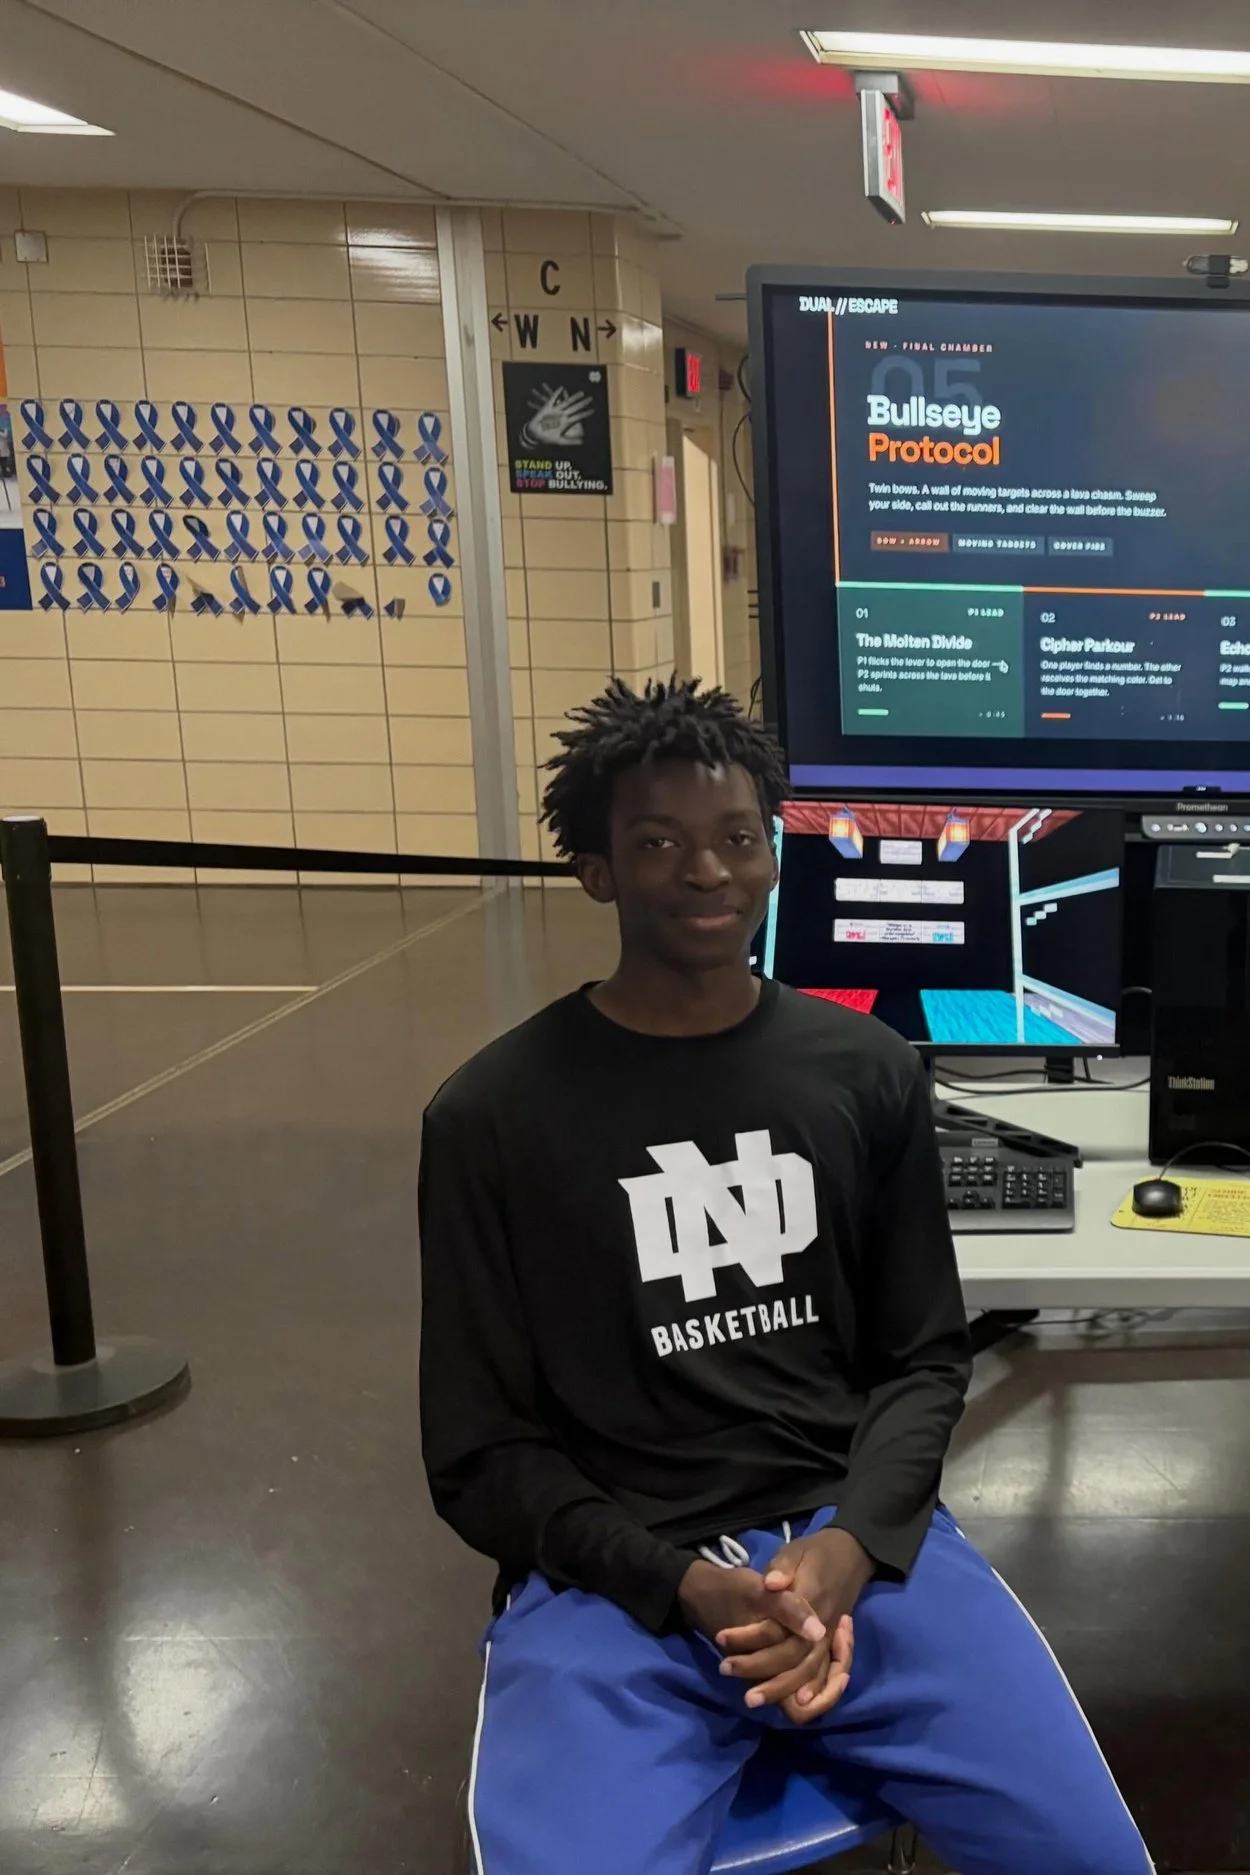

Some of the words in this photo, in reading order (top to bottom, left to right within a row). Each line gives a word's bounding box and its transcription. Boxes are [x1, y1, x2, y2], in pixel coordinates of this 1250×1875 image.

[540, 260, 561, 296] C
[514, 314, 539, 349] W
[570, 317, 592, 352] N
[865, 341, 888, 350] NEW
[903, 342, 935, 351] FINAL
[940, 343, 993, 352] CHAMBER
[867, 394, 1001, 436] Bullseye
[869, 432, 1000, 466] Protocol
[515, 460, 552, 470] STAND
[515, 469, 553, 479] SPEAK
[516, 479, 545, 489] STOP
[868, 482, 891, 494] Twin
[892, 484, 920, 495] bows.
[921, 484, 930, 495] A
[931, 485, 950, 496] wall
[951, 485, 961, 496] of
[962, 486, 997, 499] moving
[998, 487, 1030, 500] targets
[1031, 489, 1062, 499] across
[1070, 488, 1090, 500] lava
[1091, 489, 1124, 501] chasm.
[1125, 490, 1157, 502] Sweep
[869, 500, 890, 512] your
[891, 500, 914, 512] side,
[915, 501, 932, 512] call
[933, 501, 949, 512] out
[950, 501, 966, 512] the
[967, 503, 1005, 515] runners,
[1006, 504, 1024, 514] and
[1025, 504, 1048, 515] clear
[1049, 505, 1065, 515] the
[1066, 505, 1085, 516] wall
[1085, 505, 1116, 517] before
[1117, 506, 1132, 517] the
[1133, 506, 1167, 518] buzzer.
[909, 538, 940, 547] ARROW
[958, 538, 994, 548] MOVING
[996, 539, 1036, 549] TARGETS
[1052, 541, 1083, 551] COVER
[856, 608, 869, 619] 01
[1040, 612, 1056, 624] 02
[1220, 616, 1236, 627] 03
[856, 633, 882, 649] The
[883, 633, 931, 649] Molten
[931, 634, 973, 650] Divide
[1040, 636, 1084, 655] Cipher
[1084, 637, 1136, 654] Parkour
[857, 656, 867, 666] P1
[868, 656, 890, 667] flicks
[890, 656, 904, 667] the
[905, 657, 925, 668] lever
[926, 658, 935, 668] to
[936, 659, 957, 670] open
[957, 658, 971, 669] the
[971, 659, 990, 669] door
[1040, 660, 1058, 671] One
[1059, 661, 1083, 673] player
[1084, 660, 1104, 671] finds
[1144, 662, 1160, 672] The
[1160, 662, 1182, 673] other
[857, 670, 869, 680] P2
[870, 670, 898, 682] sprints
[898, 671, 925, 681] across
[926, 671, 940, 681] the
[940, 671, 957, 681] lava
[958, 671, 985, 682] before
[1041, 674, 1075, 684] receives
[1075, 674, 1089, 684] the
[1090, 674, 1125, 686] matching
[1163, 675, 1173, 685] to
[1041, 687, 1055, 697] the
[1056, 687, 1074, 697] door
[1177, 802, 1229, 813] Promethean
[1168, 1075, 1215, 1091] ThinkStation
[651, 1295, 819, 1357] BASKETBALL
